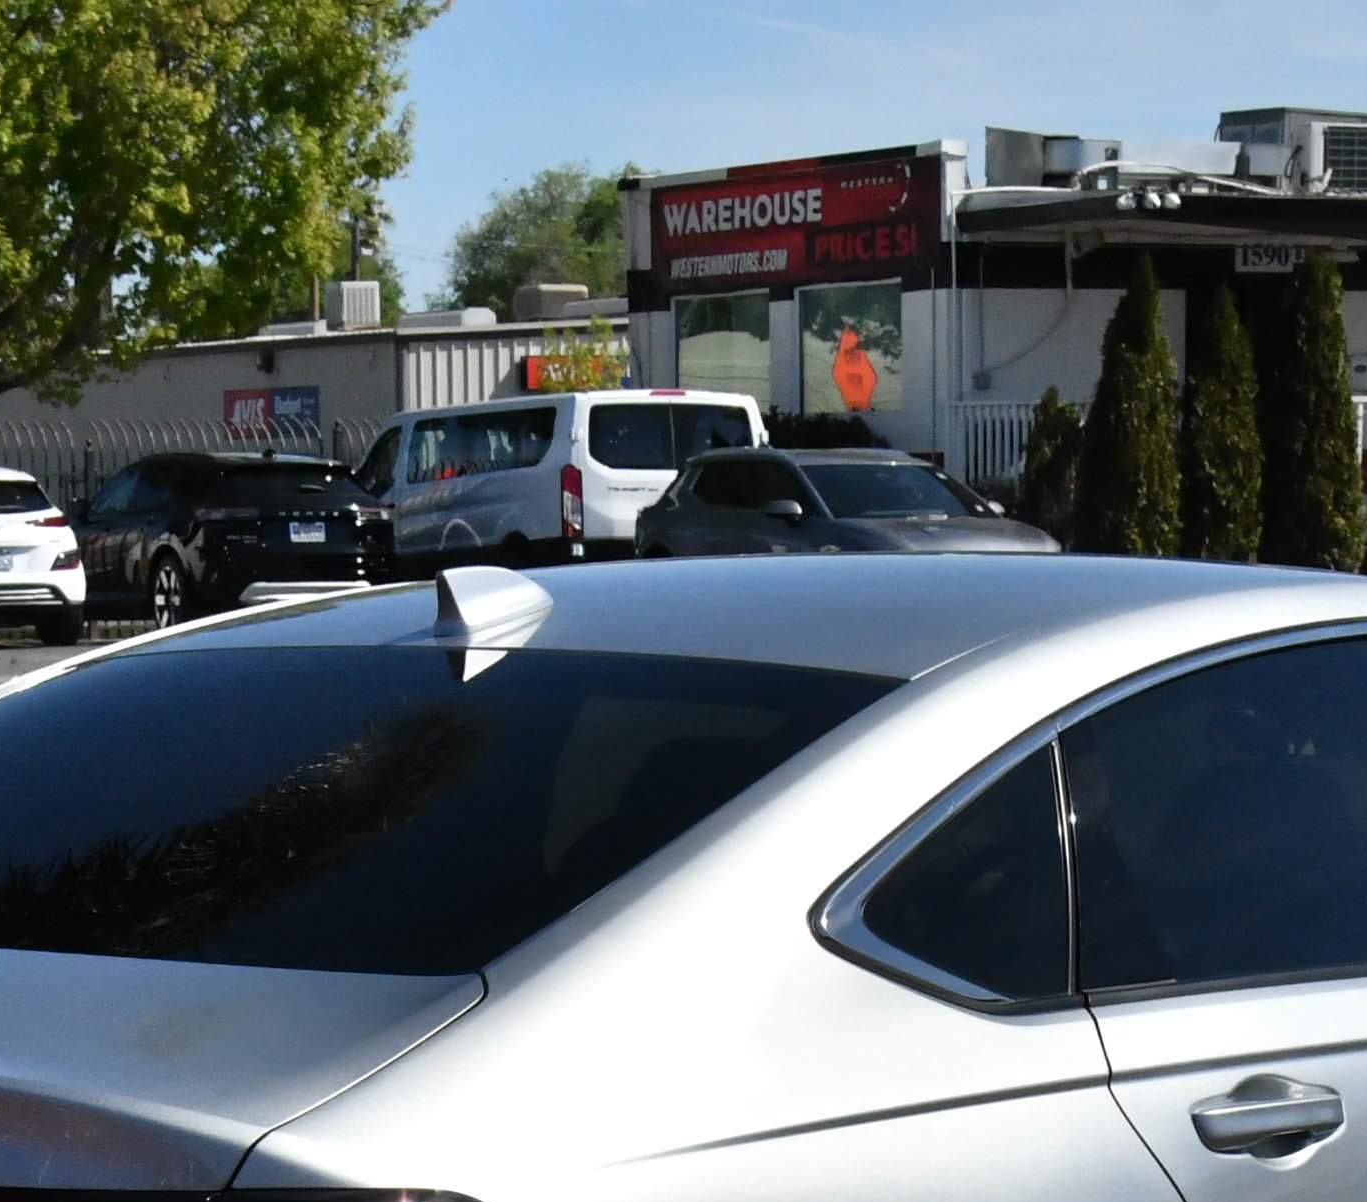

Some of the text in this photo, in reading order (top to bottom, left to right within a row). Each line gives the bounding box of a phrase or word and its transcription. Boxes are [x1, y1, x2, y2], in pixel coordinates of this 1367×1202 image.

[664, 188, 823, 238] WAREHOUSE
[814, 223, 919, 263] PRICES!
[670, 248, 788, 280] WESTERNMOTORS.COM
